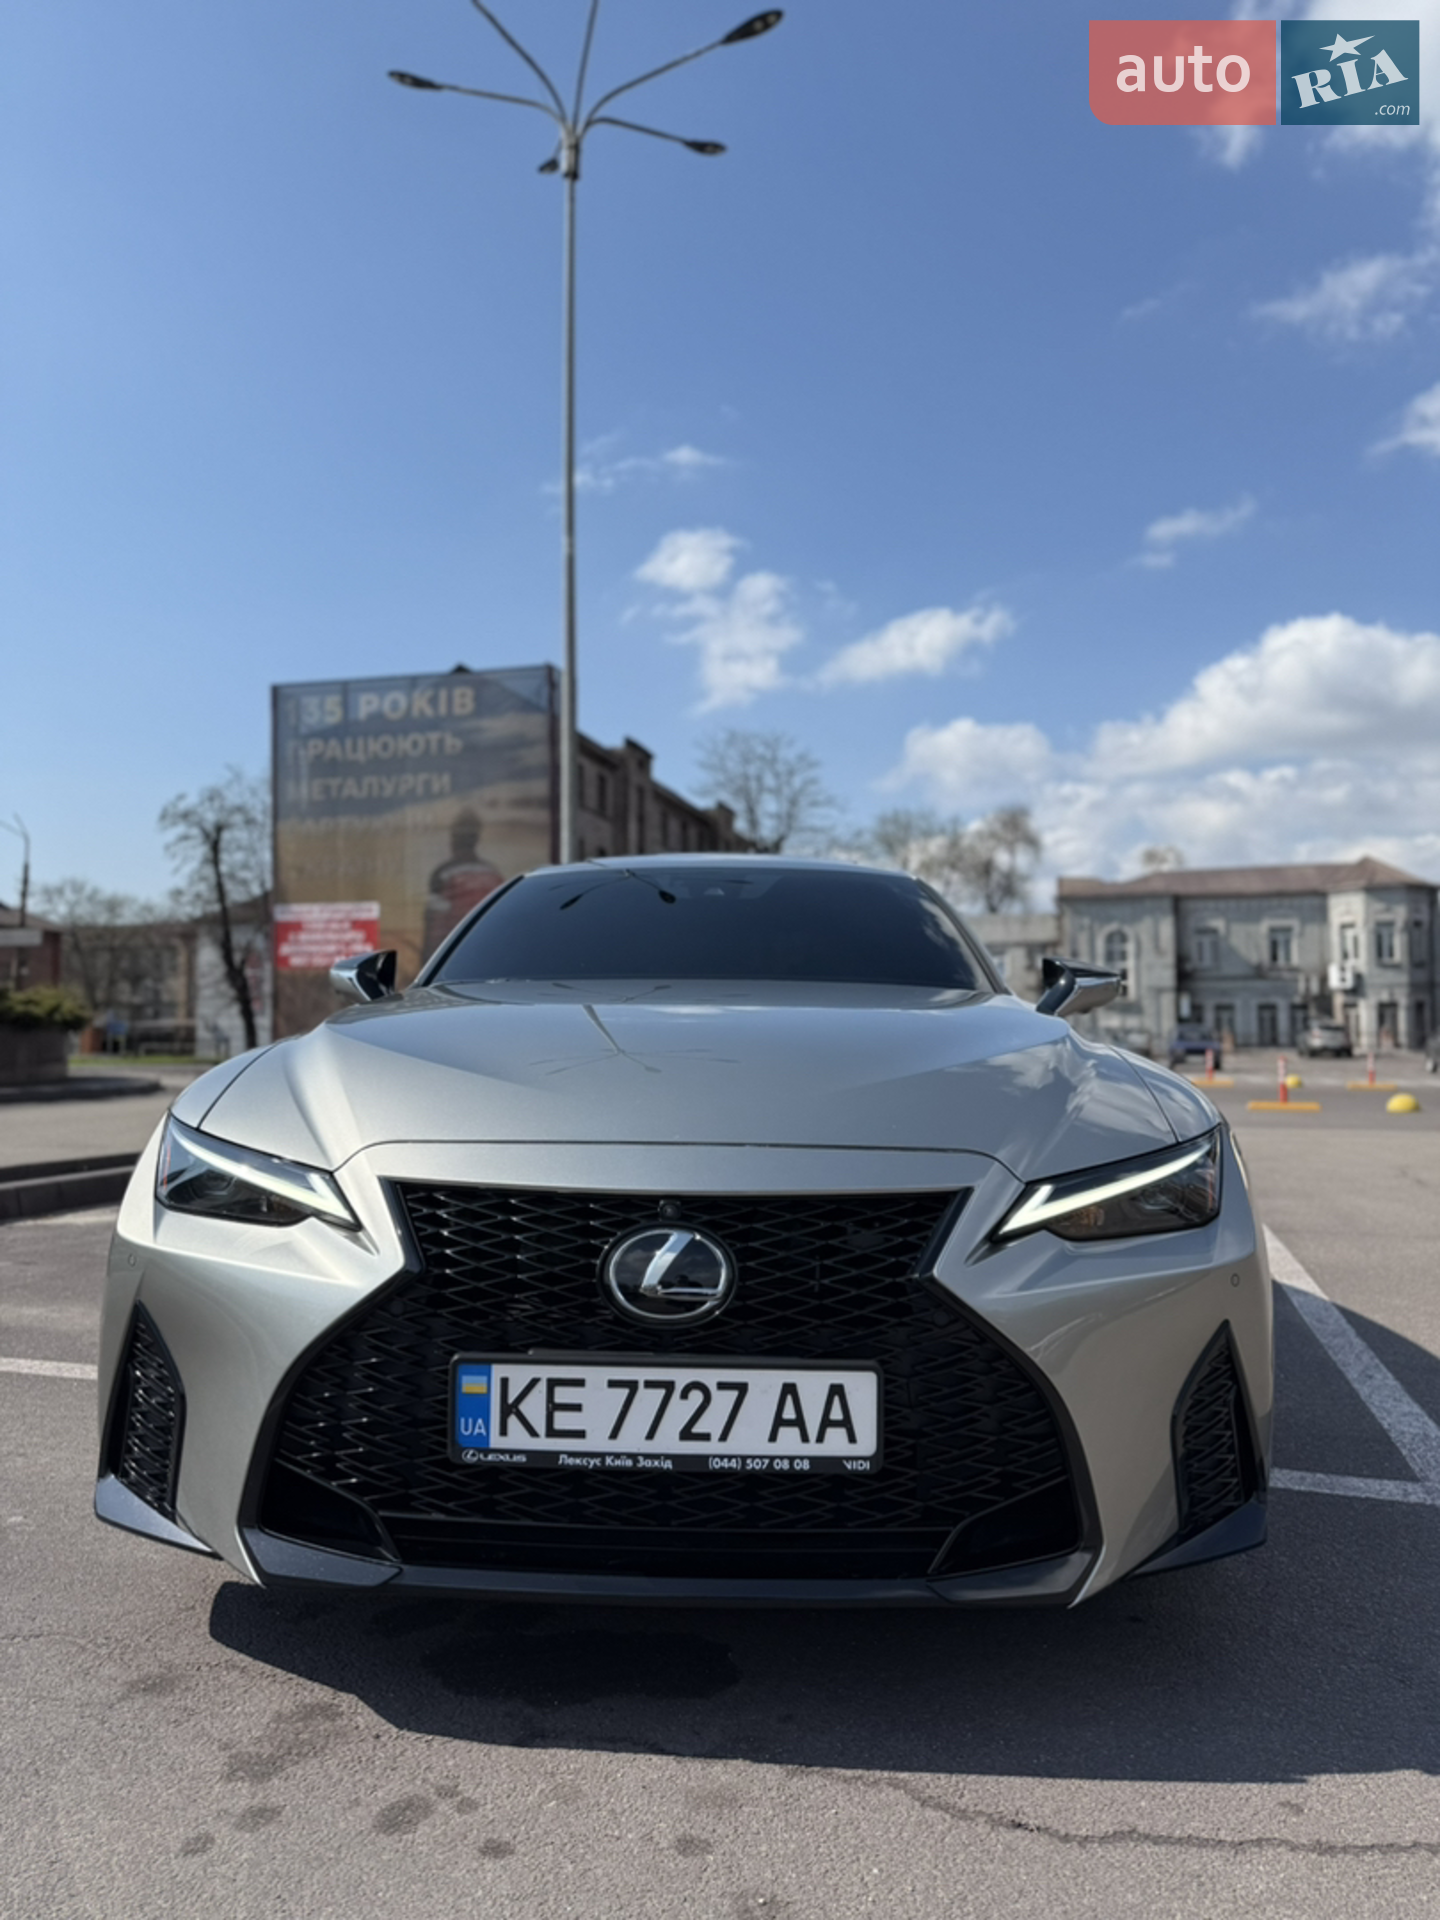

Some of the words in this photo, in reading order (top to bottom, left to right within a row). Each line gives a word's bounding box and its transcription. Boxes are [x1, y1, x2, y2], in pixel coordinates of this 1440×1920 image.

[357, 686, 476, 720] РОКІВ
[498, 1377, 587, 1440] KE
[607, 1379, 749, 1442] 7727
[767, 1382, 858, 1445] AA
[460, 1417, 487, 1437] UA
[478, 1453, 527, 1463] LEXUS
[557, 1454, 602, 1469] Лексус
[605, 1455, 633, 1467] Київ
[636, 1455, 673, 1470] Захід
[708, 1456, 742, 1471] (044)
[745, 1457, 770, 1470] 507
[773, 1458, 790, 1470] 08
[793, 1458, 810, 1471] 08
[842, 1458, 871, 1471] VIDI
